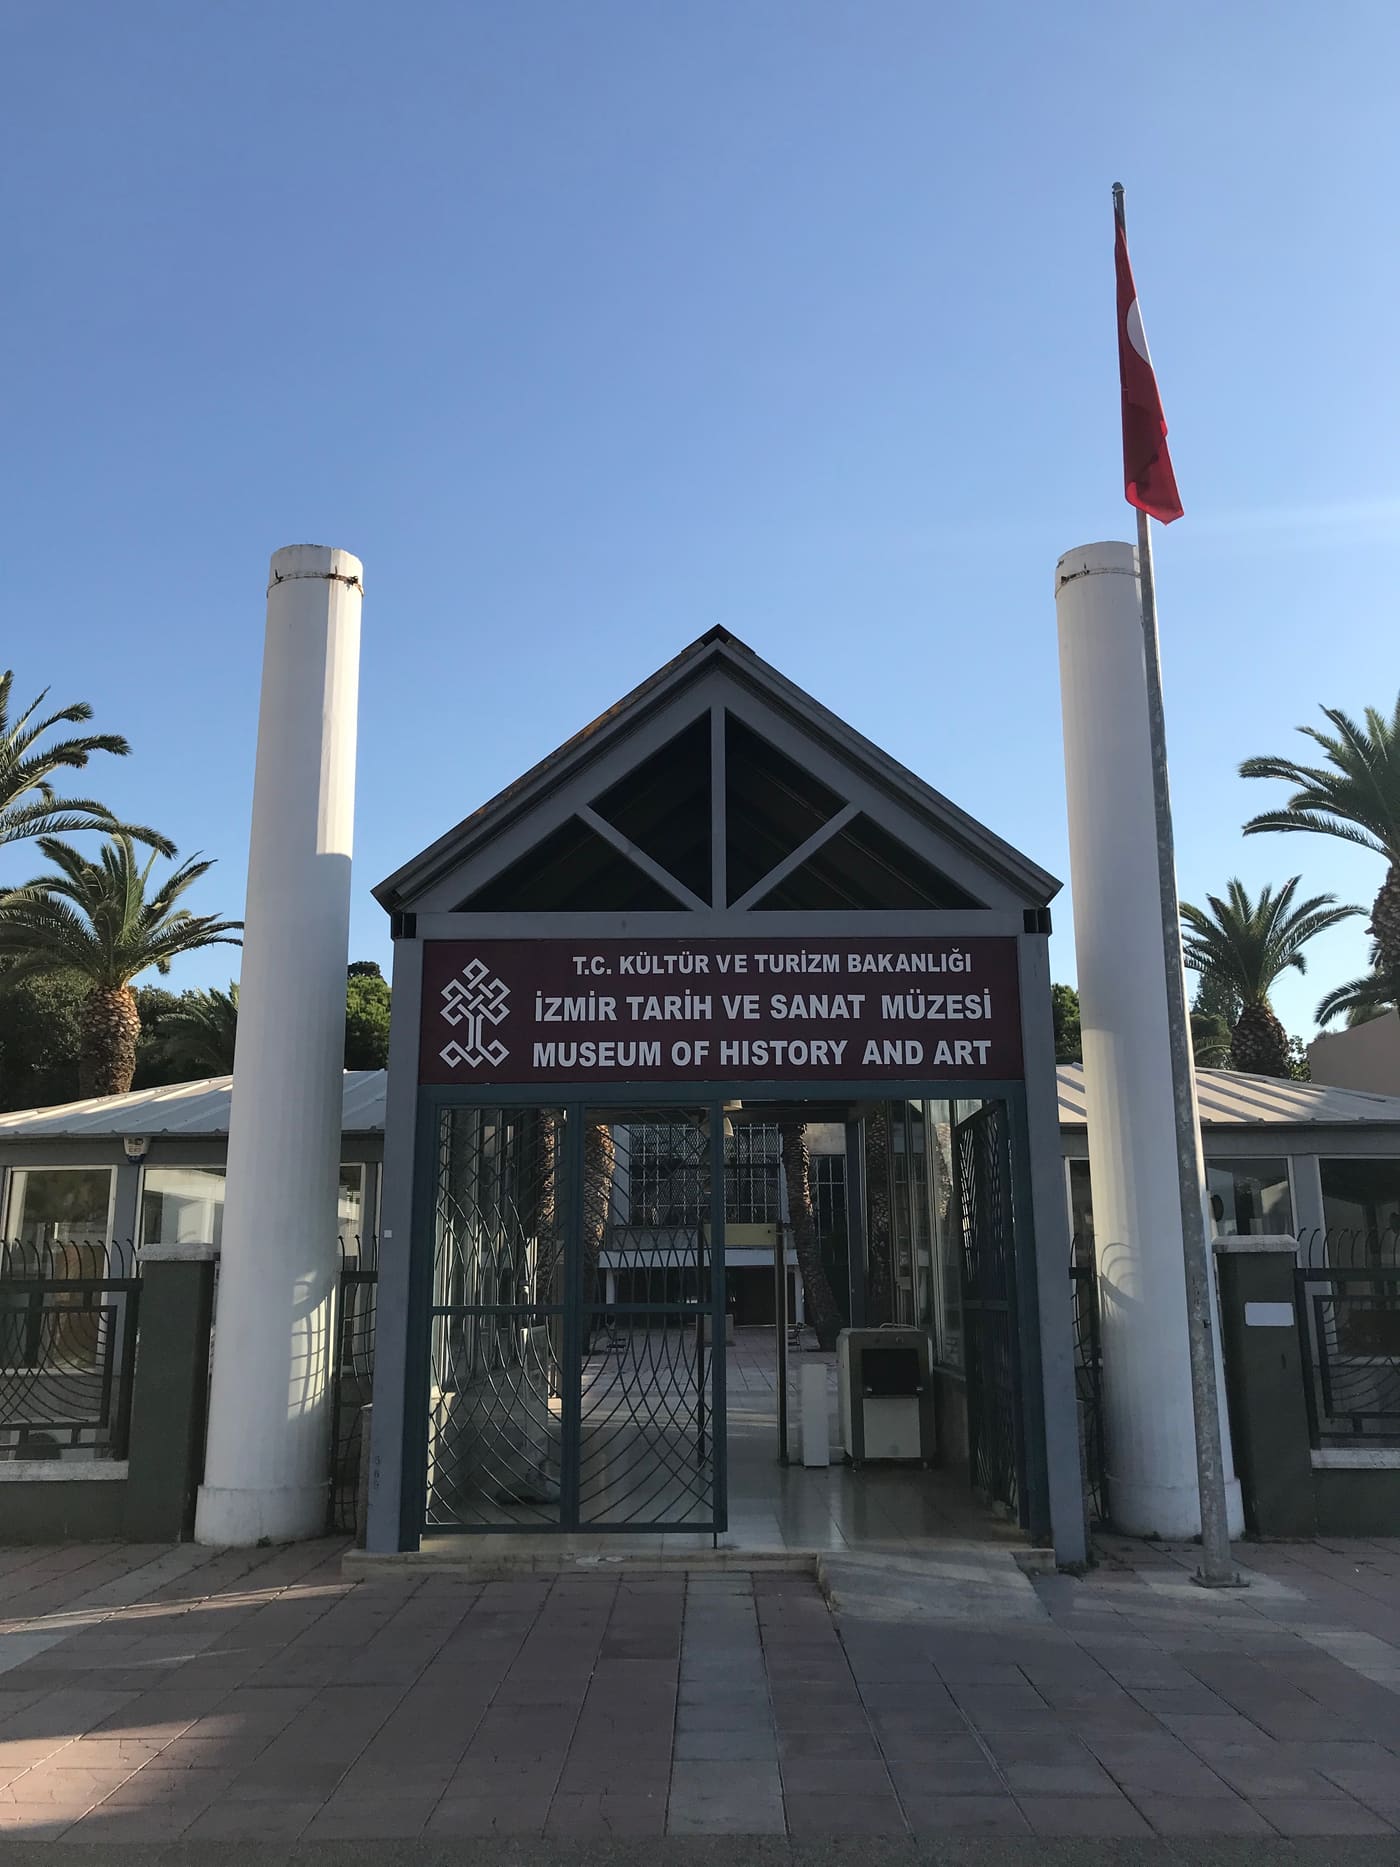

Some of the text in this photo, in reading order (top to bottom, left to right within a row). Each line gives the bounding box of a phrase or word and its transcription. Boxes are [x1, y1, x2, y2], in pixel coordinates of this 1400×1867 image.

[572, 948, 972, 975] T.C. KÜLTÜR VE TURİZM BAKANLIĞI
[535, 988, 992, 1021] İZMİR TARİH VE SANAT MÜZESİ
[532, 1040, 992, 1067] MUSEUM OF HISTORY AND ART
